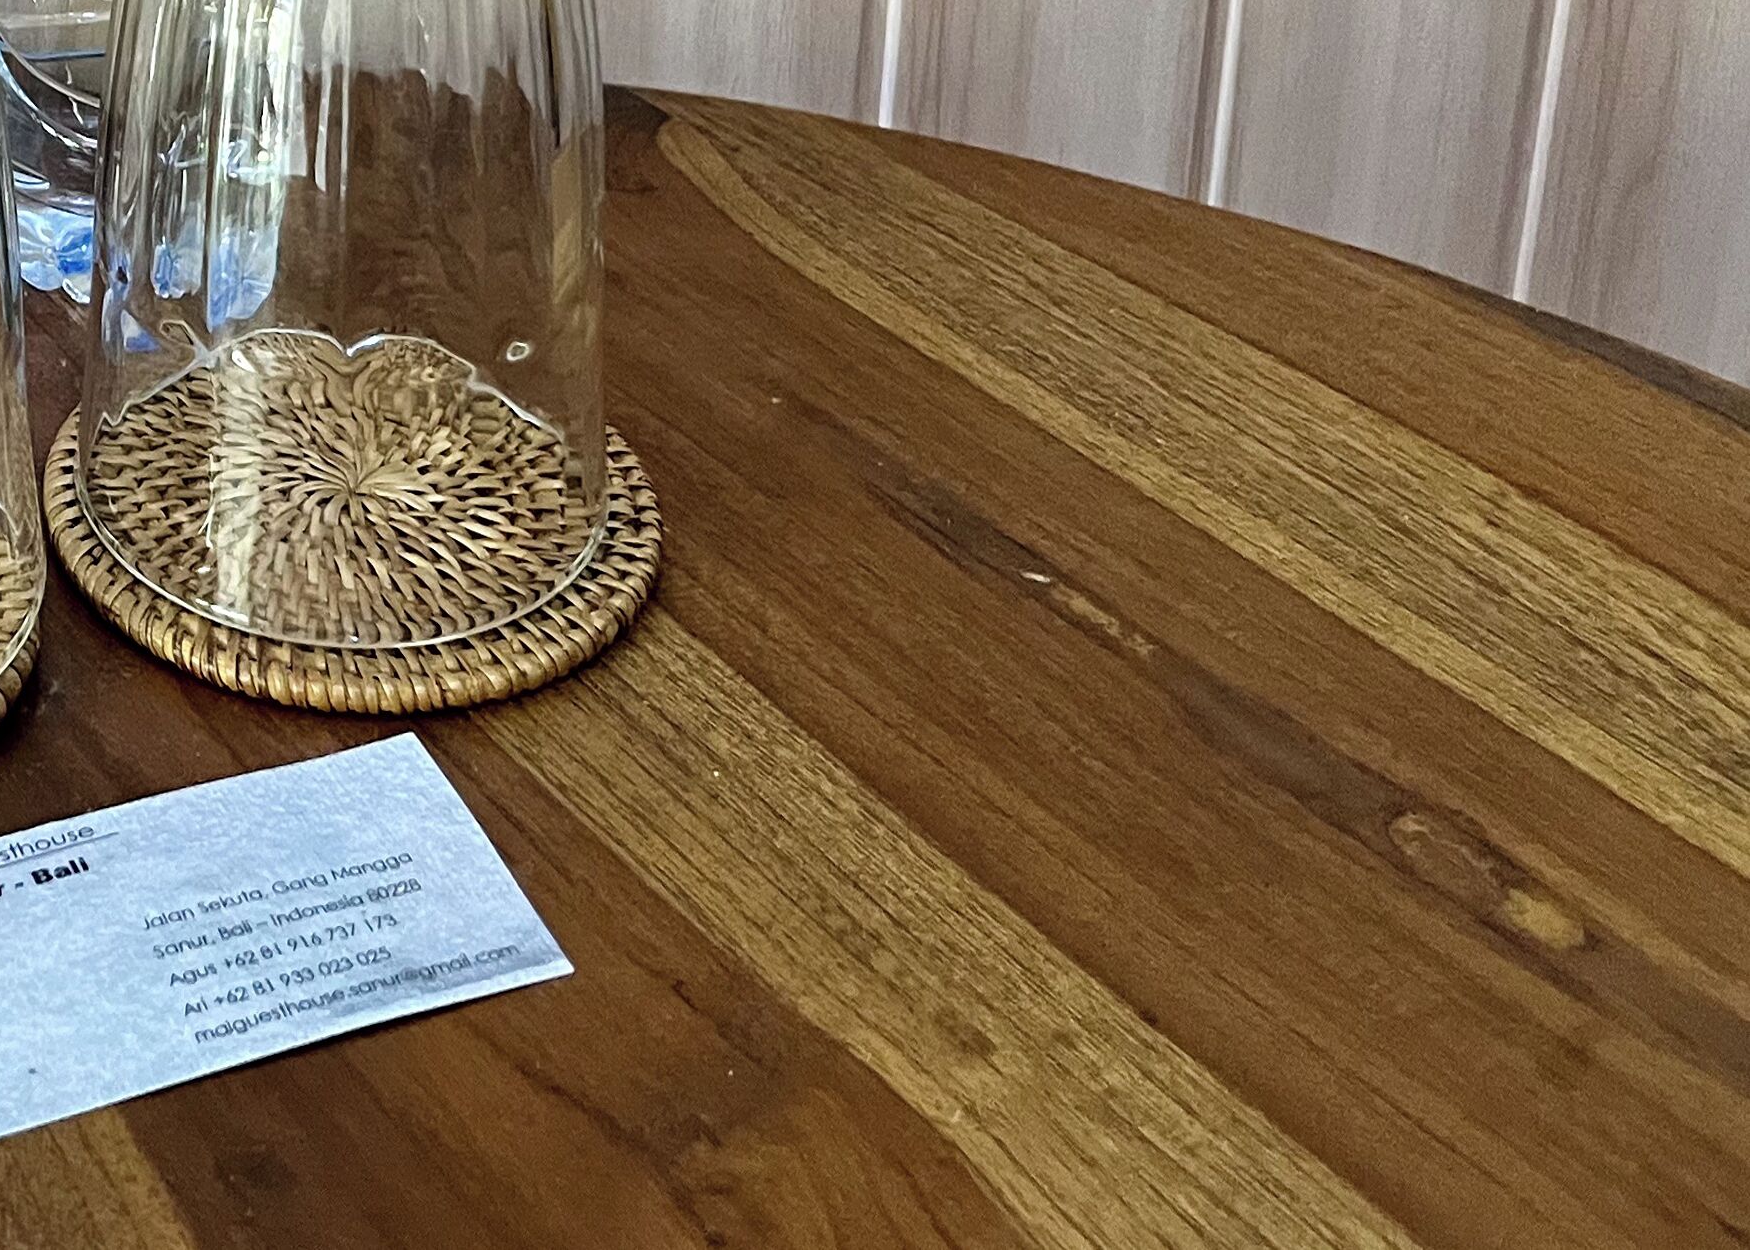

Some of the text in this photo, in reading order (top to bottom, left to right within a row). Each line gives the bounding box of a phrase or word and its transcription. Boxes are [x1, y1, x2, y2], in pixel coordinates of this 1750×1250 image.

[31, 857, 90, 885] Bali
[144, 906, 195, 932] Jalan
[271, 873, 329, 894] Gang
[330, 852, 414, 881] Mangga
[217, 919, 254, 942] Bali
[269, 893, 365, 927] Indonesia
[169, 963, 218, 988] Agus
[224, 950, 261, 969] +62
[286, 934, 323, 952] 916
[324, 922, 357, 942] 737
[214, 986, 250, 1006] +62
[317, 956, 354, 977] 023
